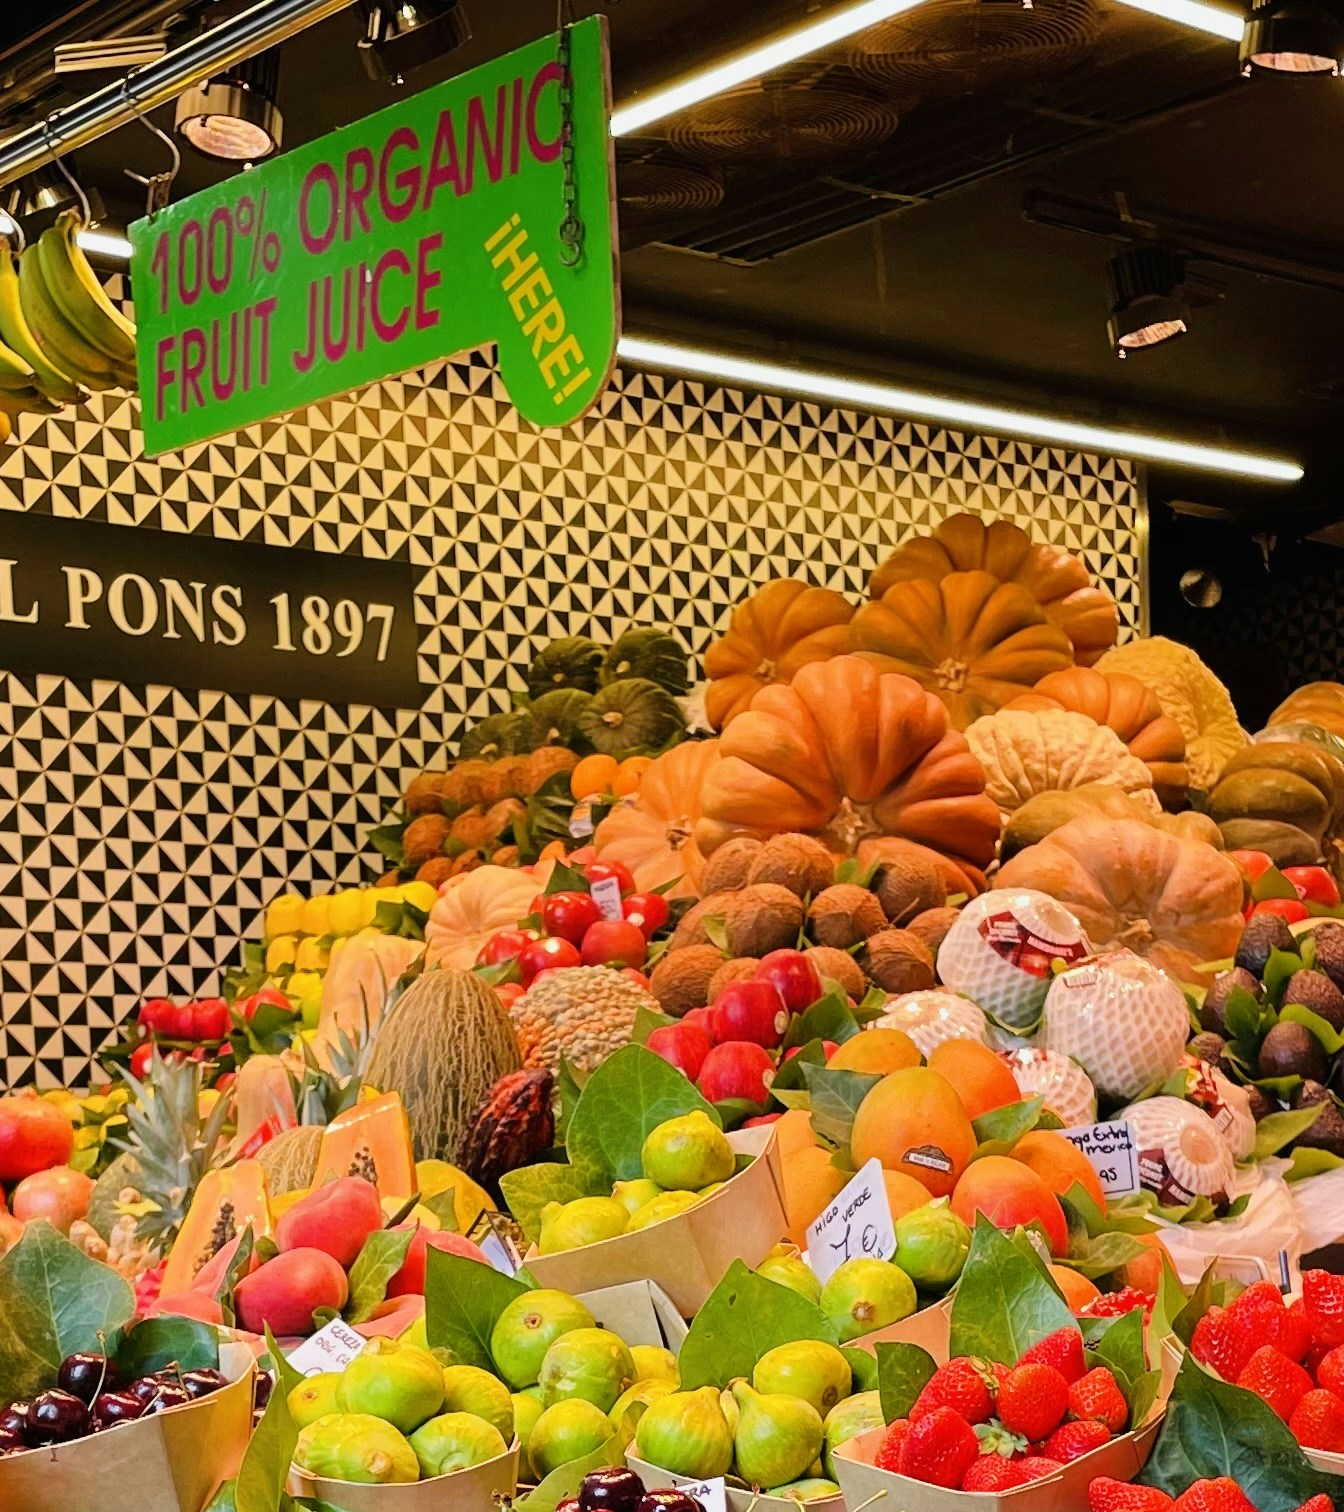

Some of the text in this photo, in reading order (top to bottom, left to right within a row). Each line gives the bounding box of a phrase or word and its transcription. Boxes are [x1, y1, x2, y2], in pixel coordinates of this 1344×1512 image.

[151, 188, 282, 315] 100%
[156, 233, 443, 422] FRUIT JUICE
[60, 566, 247, 646] PONS
[269, 592, 396, 662] 1897
[842, 1186, 872, 1222] VERDE
